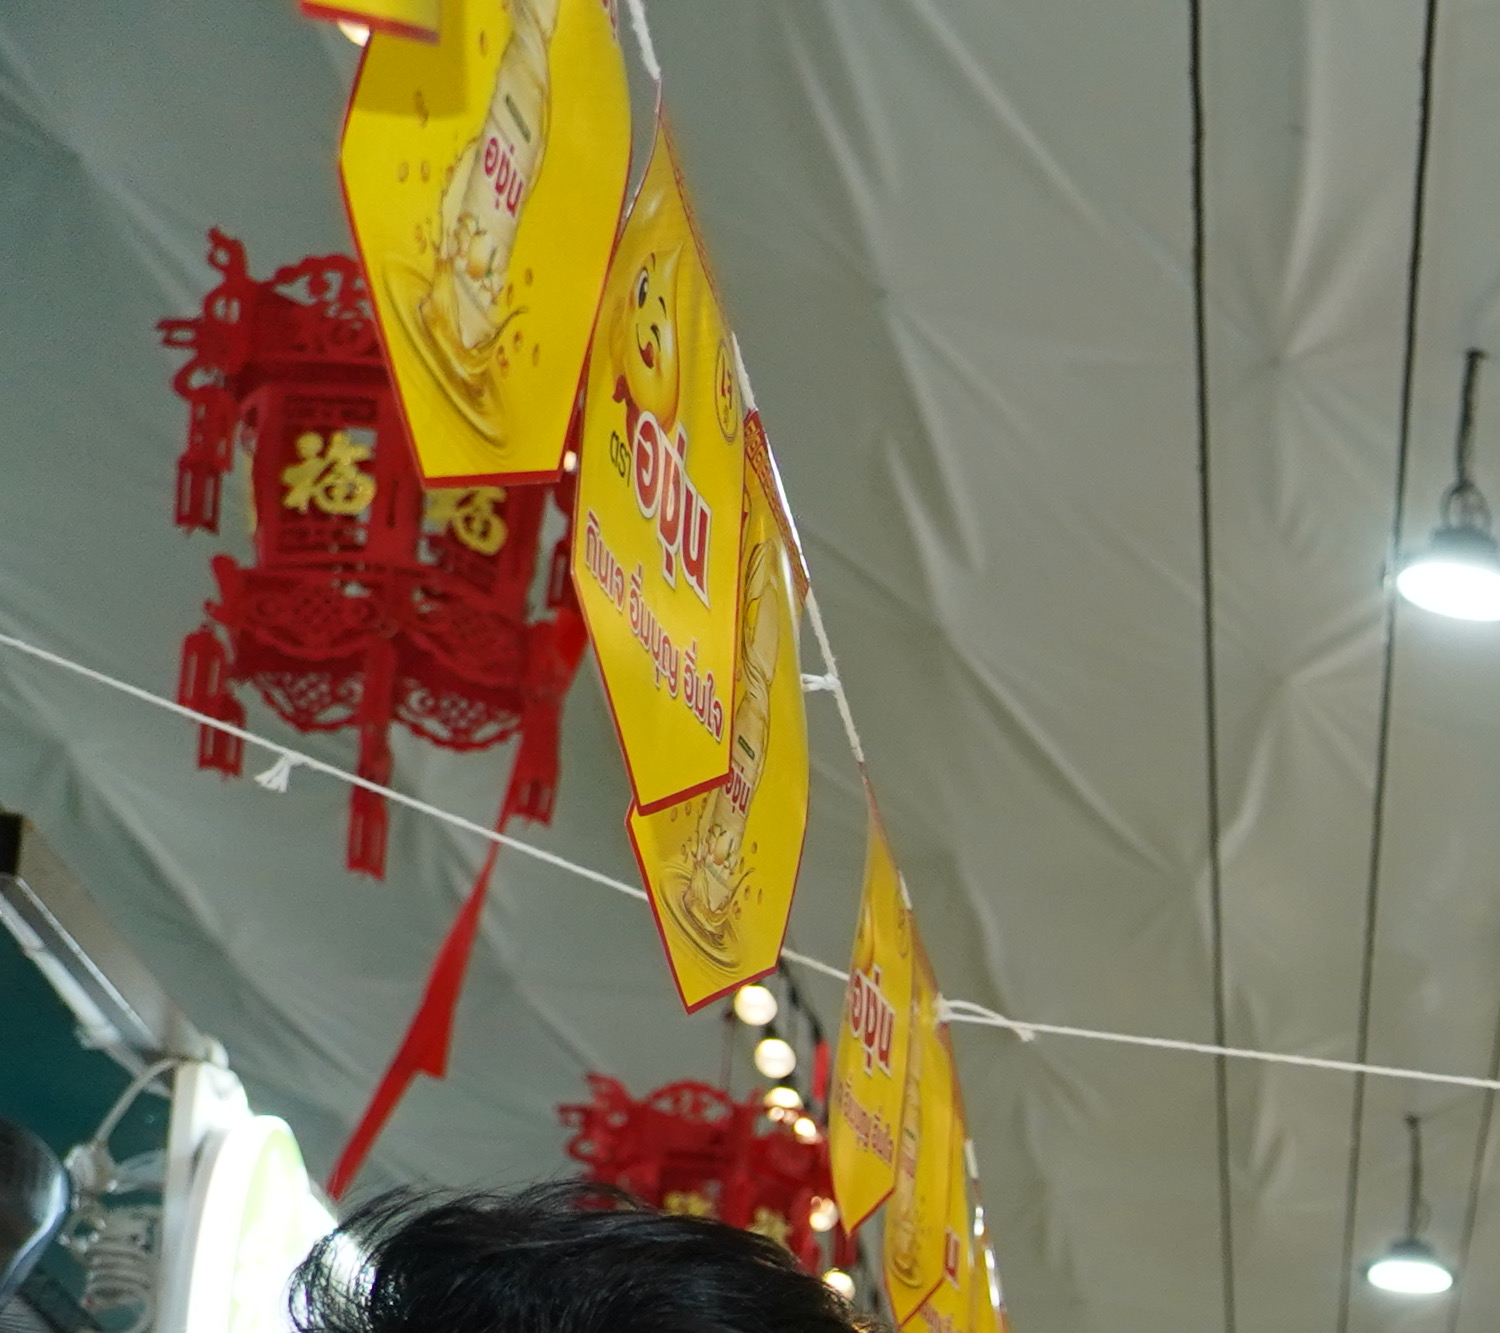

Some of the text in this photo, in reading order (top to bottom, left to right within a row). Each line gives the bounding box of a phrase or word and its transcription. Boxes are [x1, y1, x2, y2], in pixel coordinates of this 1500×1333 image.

[484, 137, 523, 218] องุ่น
[281, 431, 378, 516] 福
[610, 415, 712, 607] ตรา องุ่น
[586, 510, 724, 743] กินเจ อิ่มบุญ อิ่มใจ
